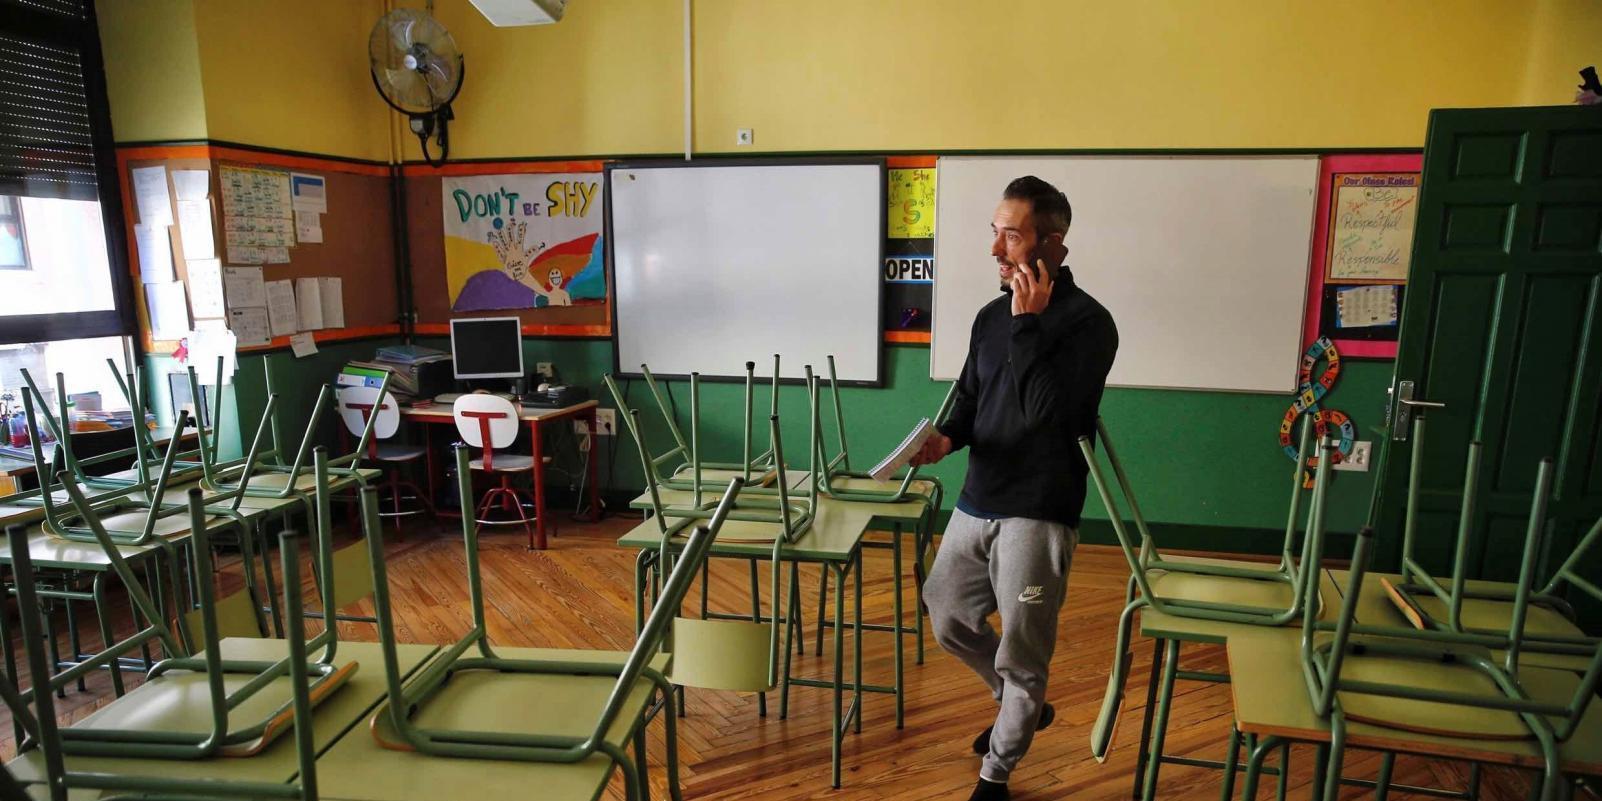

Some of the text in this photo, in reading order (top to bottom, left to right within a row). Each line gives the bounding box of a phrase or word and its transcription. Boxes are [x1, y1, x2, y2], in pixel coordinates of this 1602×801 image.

[452, 181, 599, 223] DON'T BE SHY
[885, 259, 934, 281] OPEN
[1024, 586, 1043, 595] NIKE
